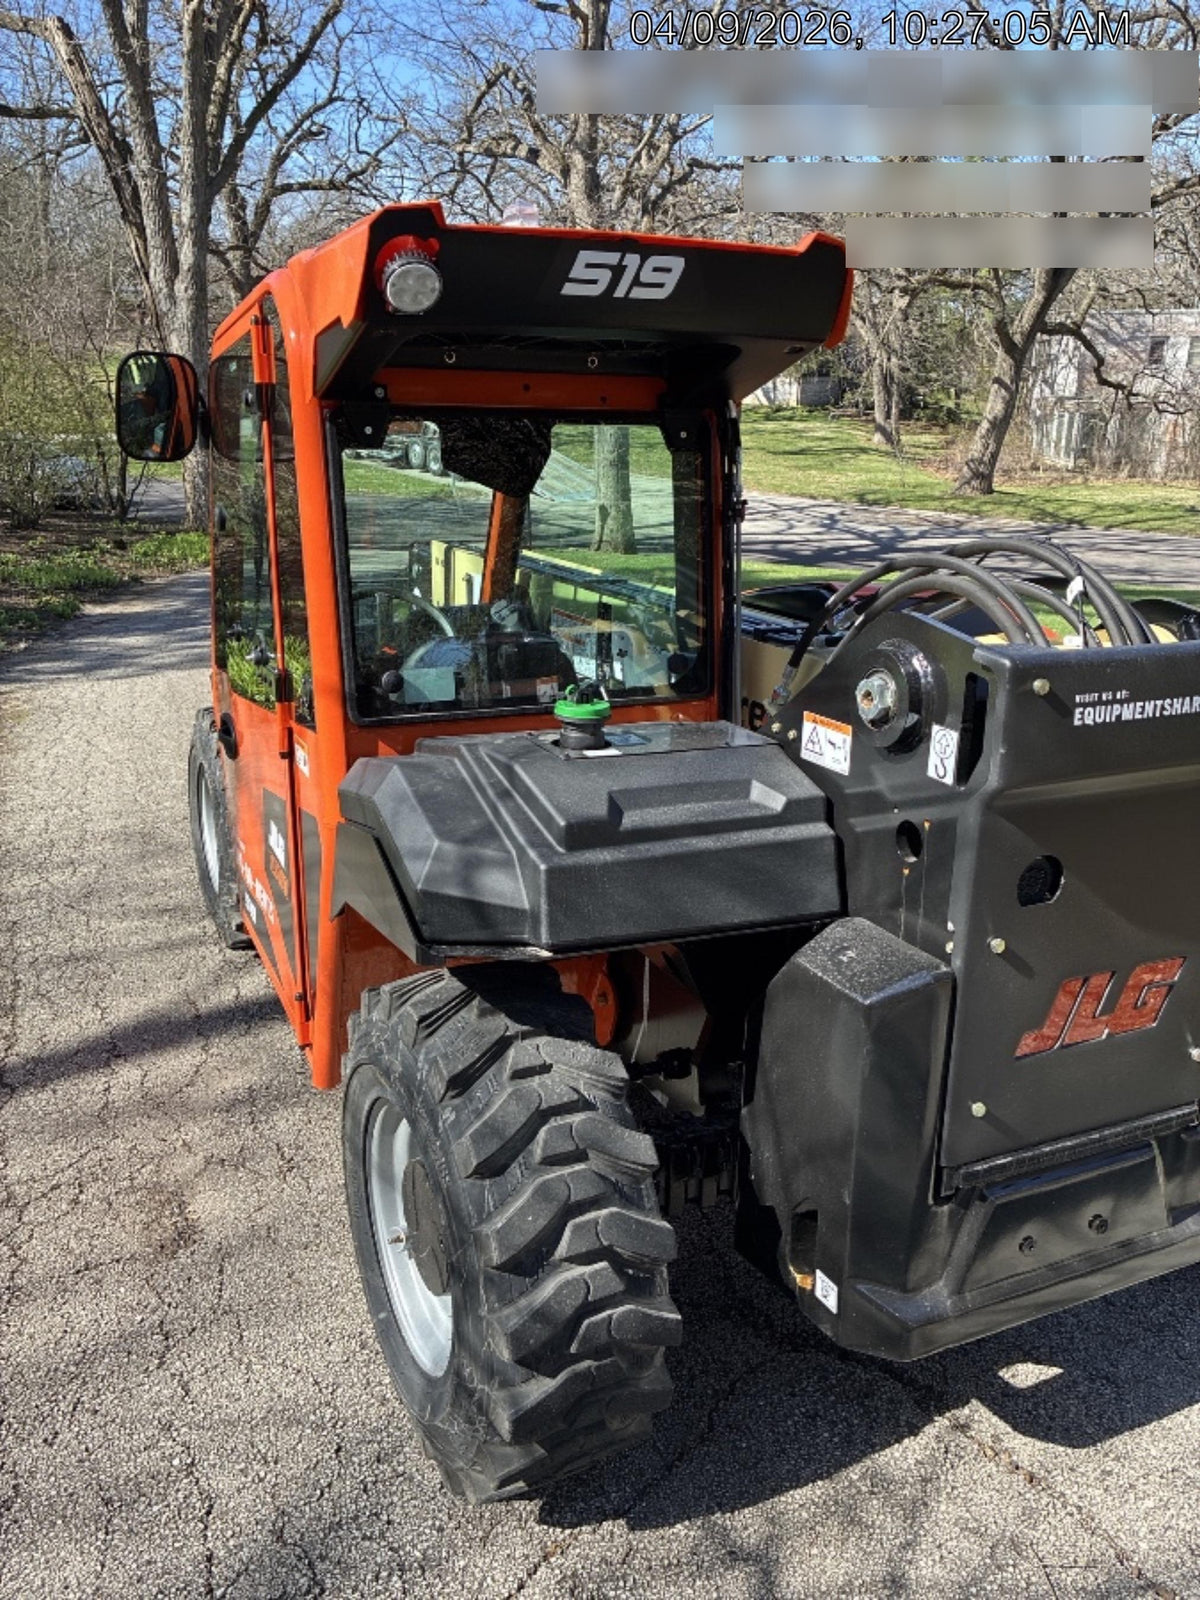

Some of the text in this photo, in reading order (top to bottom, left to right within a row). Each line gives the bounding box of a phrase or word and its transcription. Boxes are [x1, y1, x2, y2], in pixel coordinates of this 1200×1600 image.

[559, 249, 686, 300] 519
[1073, 695, 1200, 726] EQUIPMENTSHAR
[1014, 956, 1188, 1061] JLG
